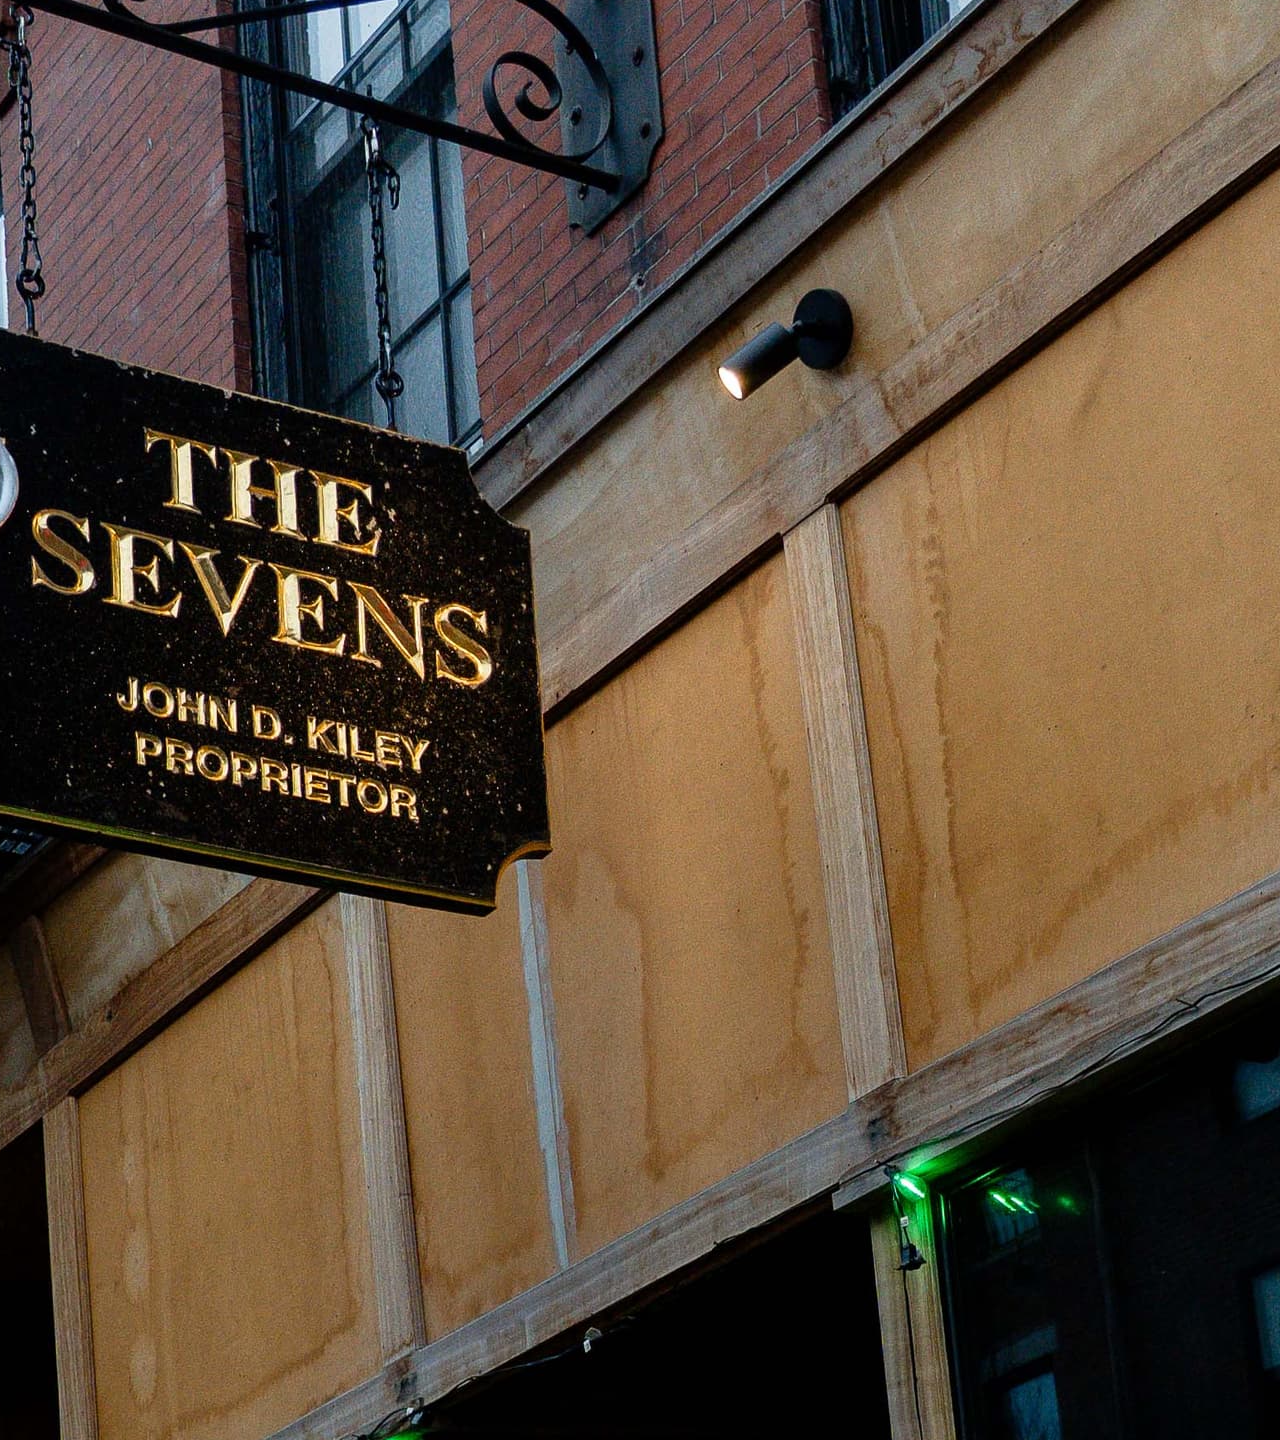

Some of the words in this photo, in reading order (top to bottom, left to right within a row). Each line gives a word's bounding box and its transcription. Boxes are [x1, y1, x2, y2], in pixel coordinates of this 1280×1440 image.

[144, 428, 382, 556] THE
[30, 509, 493, 688] SEVENS
[117, 676, 239, 733] JOHN
[253, 708, 292, 745] D.
[307, 717, 431, 773] KILEY
[136, 732, 419, 821] PROPRIETOR
